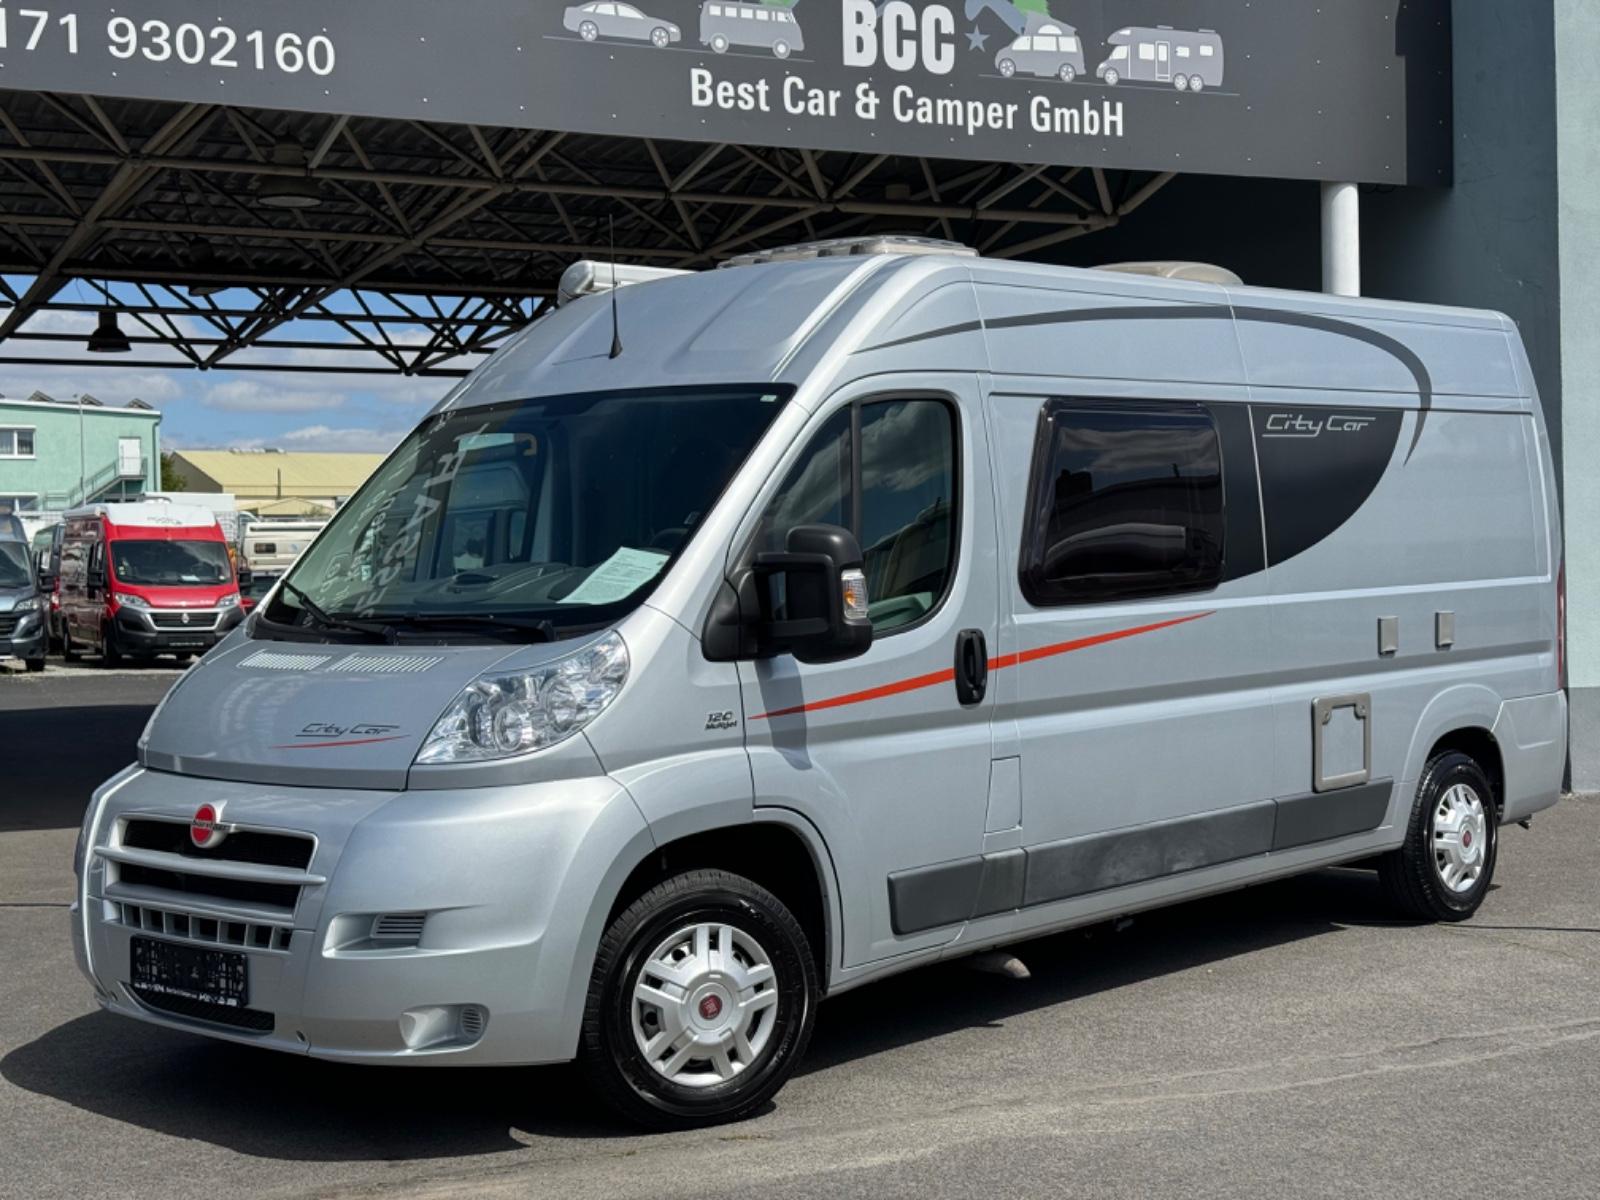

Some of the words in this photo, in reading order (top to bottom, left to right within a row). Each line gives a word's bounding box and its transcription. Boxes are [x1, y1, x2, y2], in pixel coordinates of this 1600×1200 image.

[107, 17, 336, 76] 9302160
[842, 0, 955, 75] BCC
[690, 67, 770, 112] Best
[783, 76, 842, 117] Car
[855, 83, 880, 120] &
[893, 86, 1018, 136] Camper
[1030, 97, 1124, 137] GmbH
[1262, 414, 1323, 437] City
[1326, 415, 1376, 431] Car
[296, 723, 349, 738] City
[350, 724, 400, 734] Car
